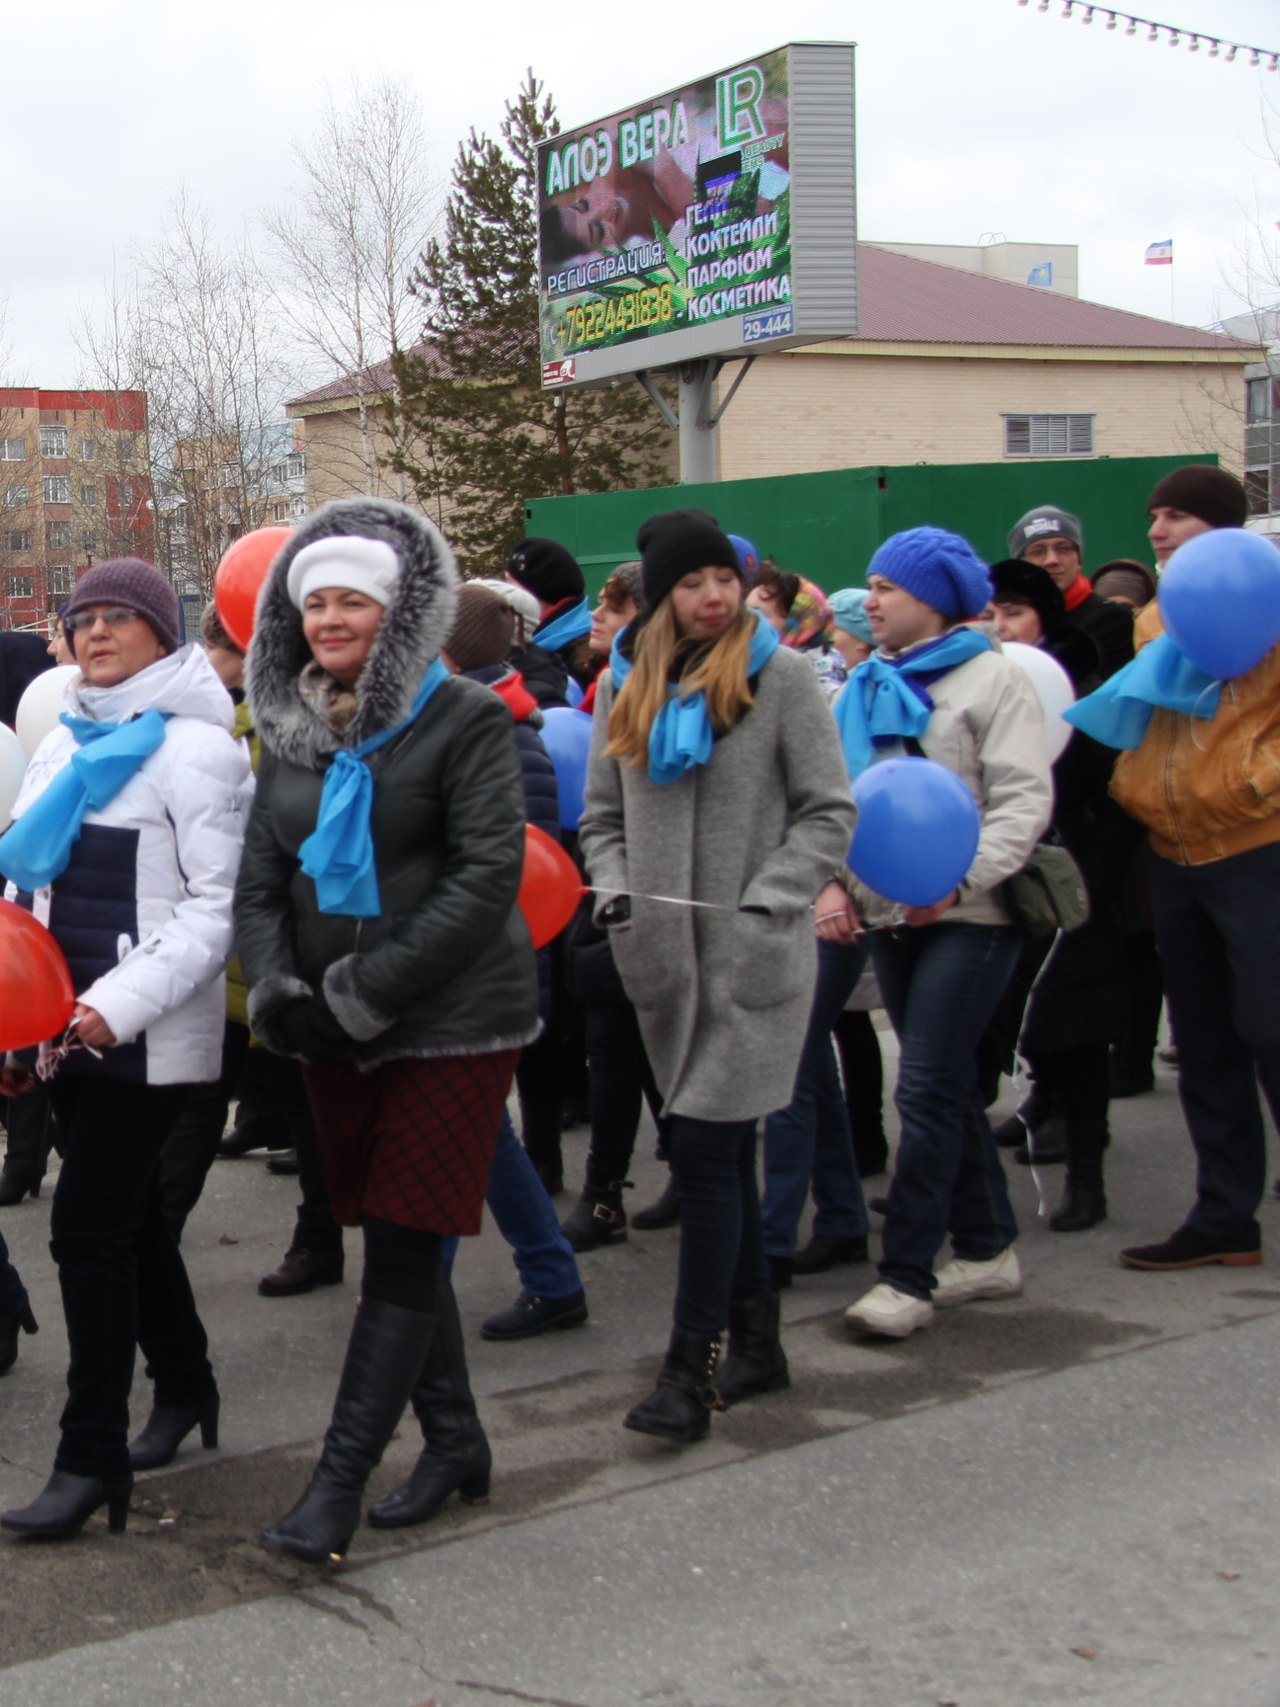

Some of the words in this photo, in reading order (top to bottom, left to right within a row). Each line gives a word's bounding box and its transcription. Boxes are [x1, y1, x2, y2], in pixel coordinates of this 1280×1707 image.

[619, 99, 689, 168] ВЕРА
[716, 67, 767, 151] LR
[688, 275, 791, 321] КОСМЕТИКА
[744, 313, 791, 341] 29-444
